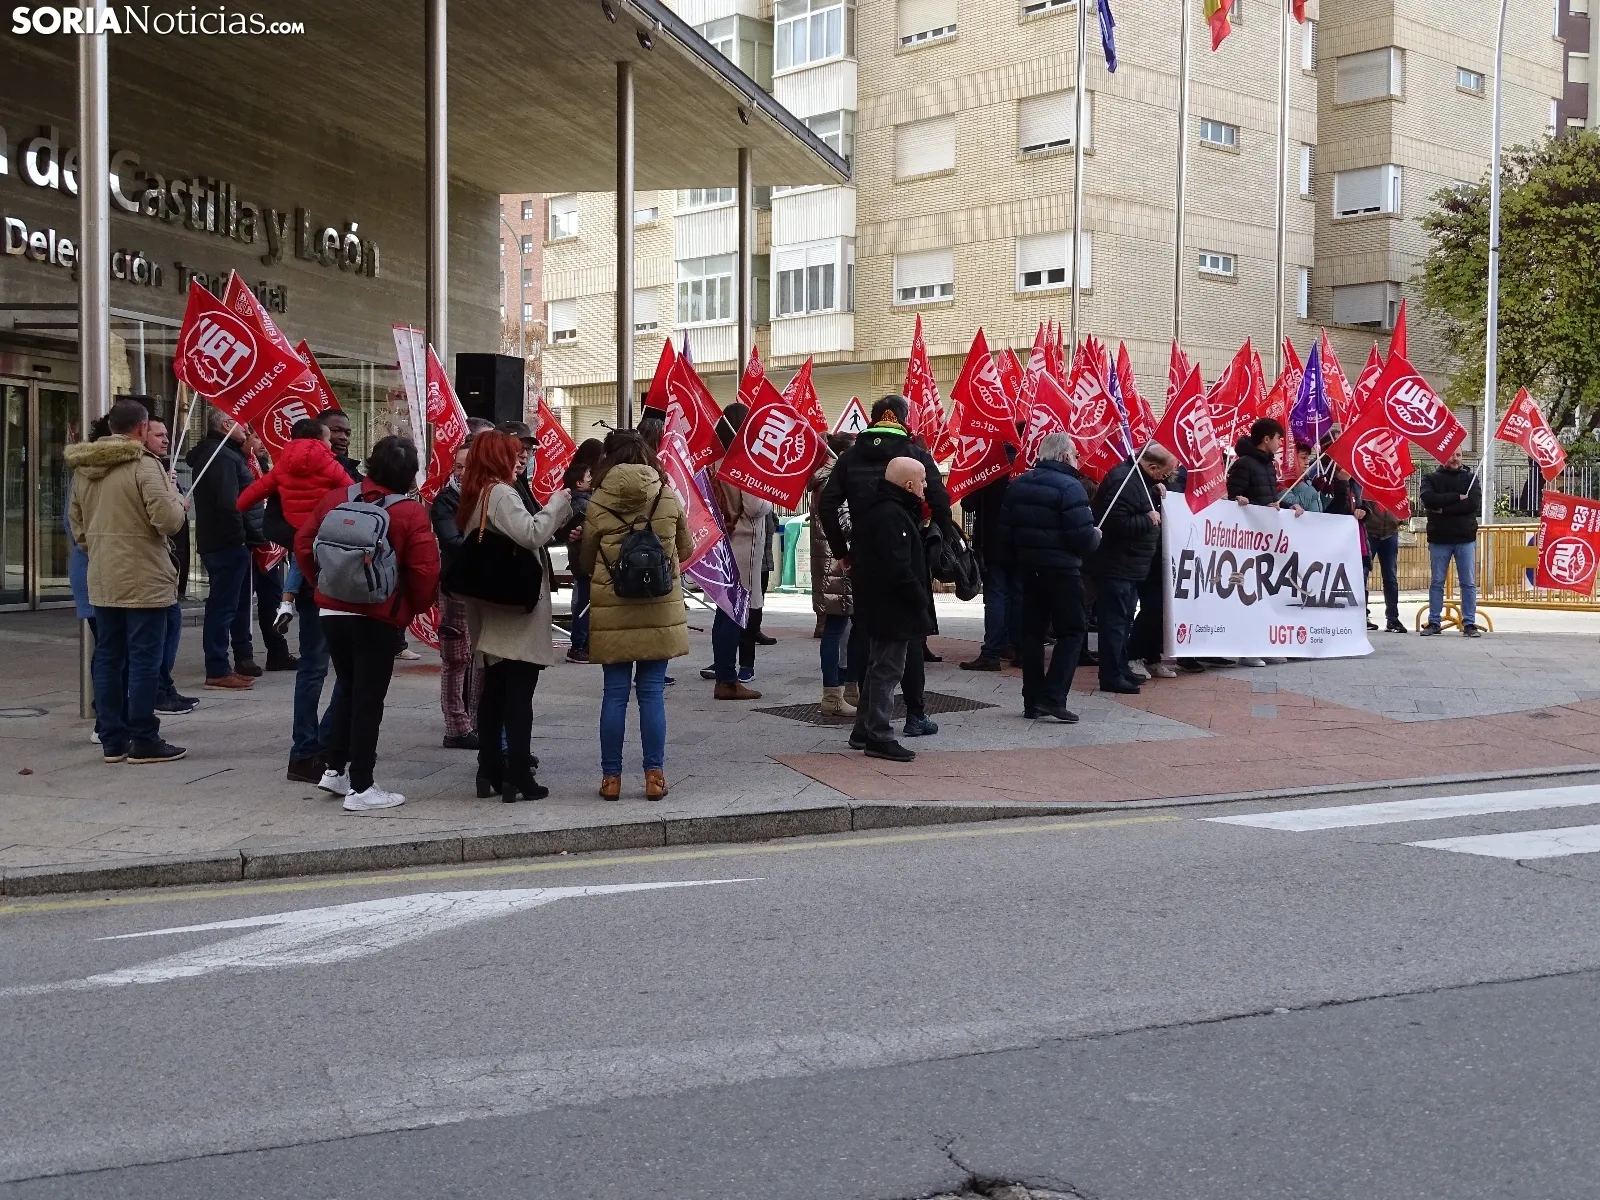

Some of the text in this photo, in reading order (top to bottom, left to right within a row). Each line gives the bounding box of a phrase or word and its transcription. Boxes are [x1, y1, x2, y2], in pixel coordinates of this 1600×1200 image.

[110, 150, 260, 243] Castilla
[265, 208, 292, 267] y
[299, 207, 380, 278] León
[5, 216, 163, 287] Deleción
[198, 317, 252, 373] UGT
[231, 361, 287, 416] www.ugt.es
[1396, 380, 1444, 420] UGT
[951, 462, 1001, 494] www.ugt.es
[1205, 519, 1289, 554] Defendamos la
[1269, 625, 1295, 645] UGT
[1309, 626, 1331, 635] Castilla
[1336, 626, 1353, 635] León
[1309, 636, 1324, 644] Soria
